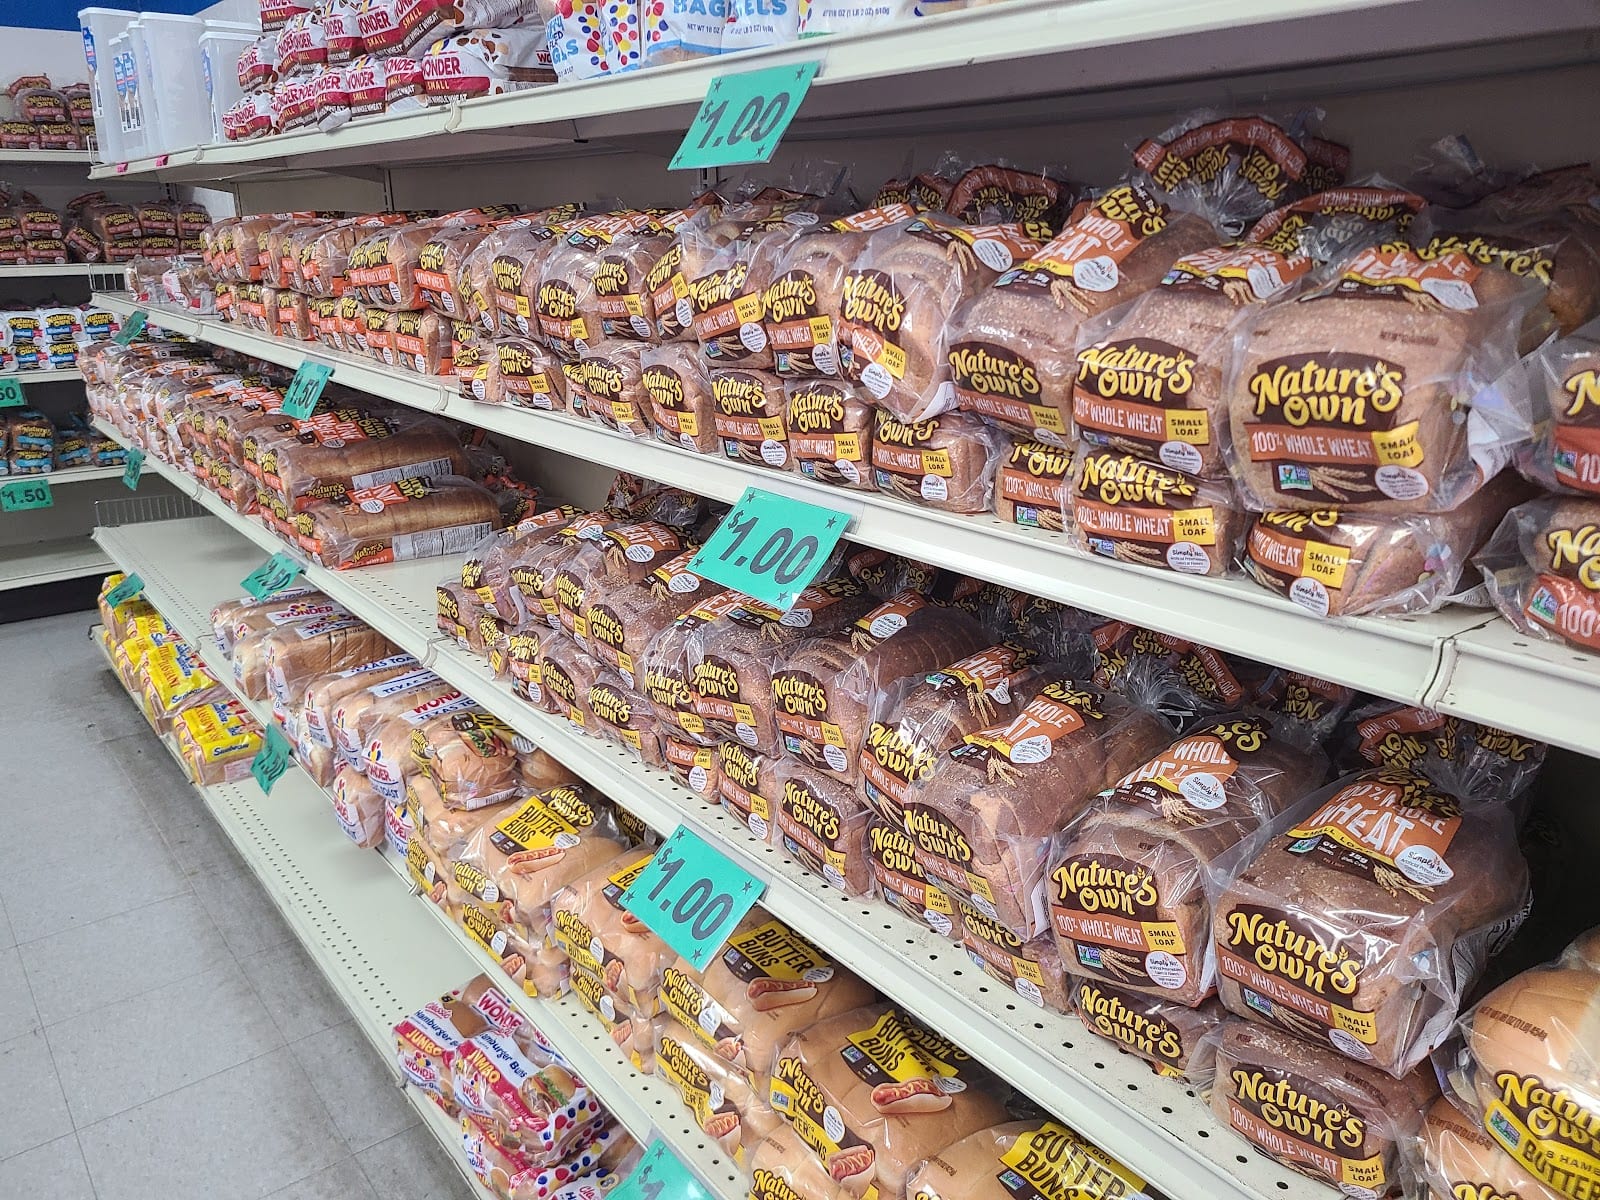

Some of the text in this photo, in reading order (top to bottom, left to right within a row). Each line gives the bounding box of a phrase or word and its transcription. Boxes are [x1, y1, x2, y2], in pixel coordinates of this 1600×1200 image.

[403, 8, 421, 29] SMALL
[424, 12, 439, 29] WHEAT
[697, 92, 791, 149] $1.00
[738, 301, 757, 311] SMALL
[742, 308, 757, 318] LOAF
[772, 299, 806, 323] Own
[843, 276, 904, 332] Nature's
[813, 323, 829, 332] SMALL
[816, 331, 829, 339] LOAF
[885, 352, 904, 363] SMALL
[885, 358, 900, 369] LOAF
[1077, 344, 1194, 394] Nature's
[950, 350, 1040, 394] Nature's
[971, 372, 1023, 398] Own
[713, 377, 765, 409] Nature's
[1100, 370, 1162, 401] Own
[1251, 360, 1402, 413] Nature's
[721, 396, 753, 415] Own
[1002, 405, 1030, 422] WHEAT
[1034, 412, 1058, 420] SMALL
[1283, 396, 1366, 425] Own
[799, 410, 831, 432] Own
[1041, 418, 1057, 427] LOAF
[1090, 405, 1162, 434] WHOLE WHEAT
[1171, 419, 1203, 427] SMALL
[1175, 428, 1199, 436] LOAF
[880, 421, 914, 446] Own
[1252, 432, 1372, 459] 100% WHOLE WHEAT
[1381, 437, 1416, 451] SMALL
[897, 454, 920, 468] WHEAT
[925, 455, 946, 463] SMALL
[929, 463, 945, 471] LOAF
[1388, 448, 1416, 460] LOAF
[1024, 478, 1050, 499] WHOLE
[1080, 456, 1196, 496] Nature's
[1099, 478, 1166, 506] Own
[1099, 512, 1170, 537] WHOLE WHEAT
[1178, 518, 1209, 526] SMALL
[1182, 528, 1206, 536] LOAF
[719, 510, 819, 585] $1.00
[1308, 552, 1342, 567] SMALL
[1311, 563, 1336, 577] LOAF
[280, 604, 333, 618] WONDER
[391, 656, 415, 664] TOA
[413, 691, 461, 714] WOND
[699, 680, 728, 699] Own
[772, 677, 827, 712] Nature's
[418, 706, 455, 720] TEXAS
[786, 695, 816, 717] Own
[1174, 741, 1231, 764] WHOLE
[518, 804, 564, 840] BUTTER
[783, 782, 839, 840] Nature's
[792, 805, 822, 839] Own
[503, 818, 535, 843] BUNS
[903, 809, 971, 862] Nature's
[1310, 802, 1415, 856] WHEAT
[647, 848, 734, 941] $1.00
[1052, 860, 1158, 907] Nature's
[931, 900, 947, 909] LOAF
[1079, 886, 1135, 915] Own
[1055, 914, 1142, 946] 100% WHOLE WHEAT
[1148, 929, 1176, 939] SMALL
[1154, 938, 1175, 947] LOAF
[744, 939, 780, 968] BUNS
[756, 927, 815, 974] BUTTER
[1228, 912, 1362, 996] Nature's
[1016, 961, 1037, 975] SMALL
[1254, 947, 1326, 995] Own
[663, 968, 704, 1016] Nature's
[669, 987, 692, 1013] Own
[1222, 956, 1329, 1020] 100% WHOLE WHEAT
[415, 1010, 451, 1042] Hamburger
[1080, 985, 1181, 1059] Nature's
[1338, 1010, 1372, 1028] SMALL
[1342, 1022, 1368, 1036] LOAF
[406, 1029, 442, 1056] JUMBO
[1098, 1019, 1154, 1056] Own
[467, 1050, 500, 1083] JUMBO
[661, 1039, 708, 1086] Nature's
[860, 1038, 903, 1073] BUNS
[670, 1056, 695, 1084] Own
[1232, 1071, 1363, 1149] Nature's
[1497, 1073, 1600, 1139] Natur
[1261, 1103, 1336, 1149] Own
[1230, 1107, 1338, 1176] 100% WHOLE WHEAT
[1014, 1151, 1079, 1200] BUNS
[1030, 1130, 1127, 1197] BUTTER
[1348, 1162, 1380, 1176] SMALL
[1351, 1172, 1378, 1183] LOAF
